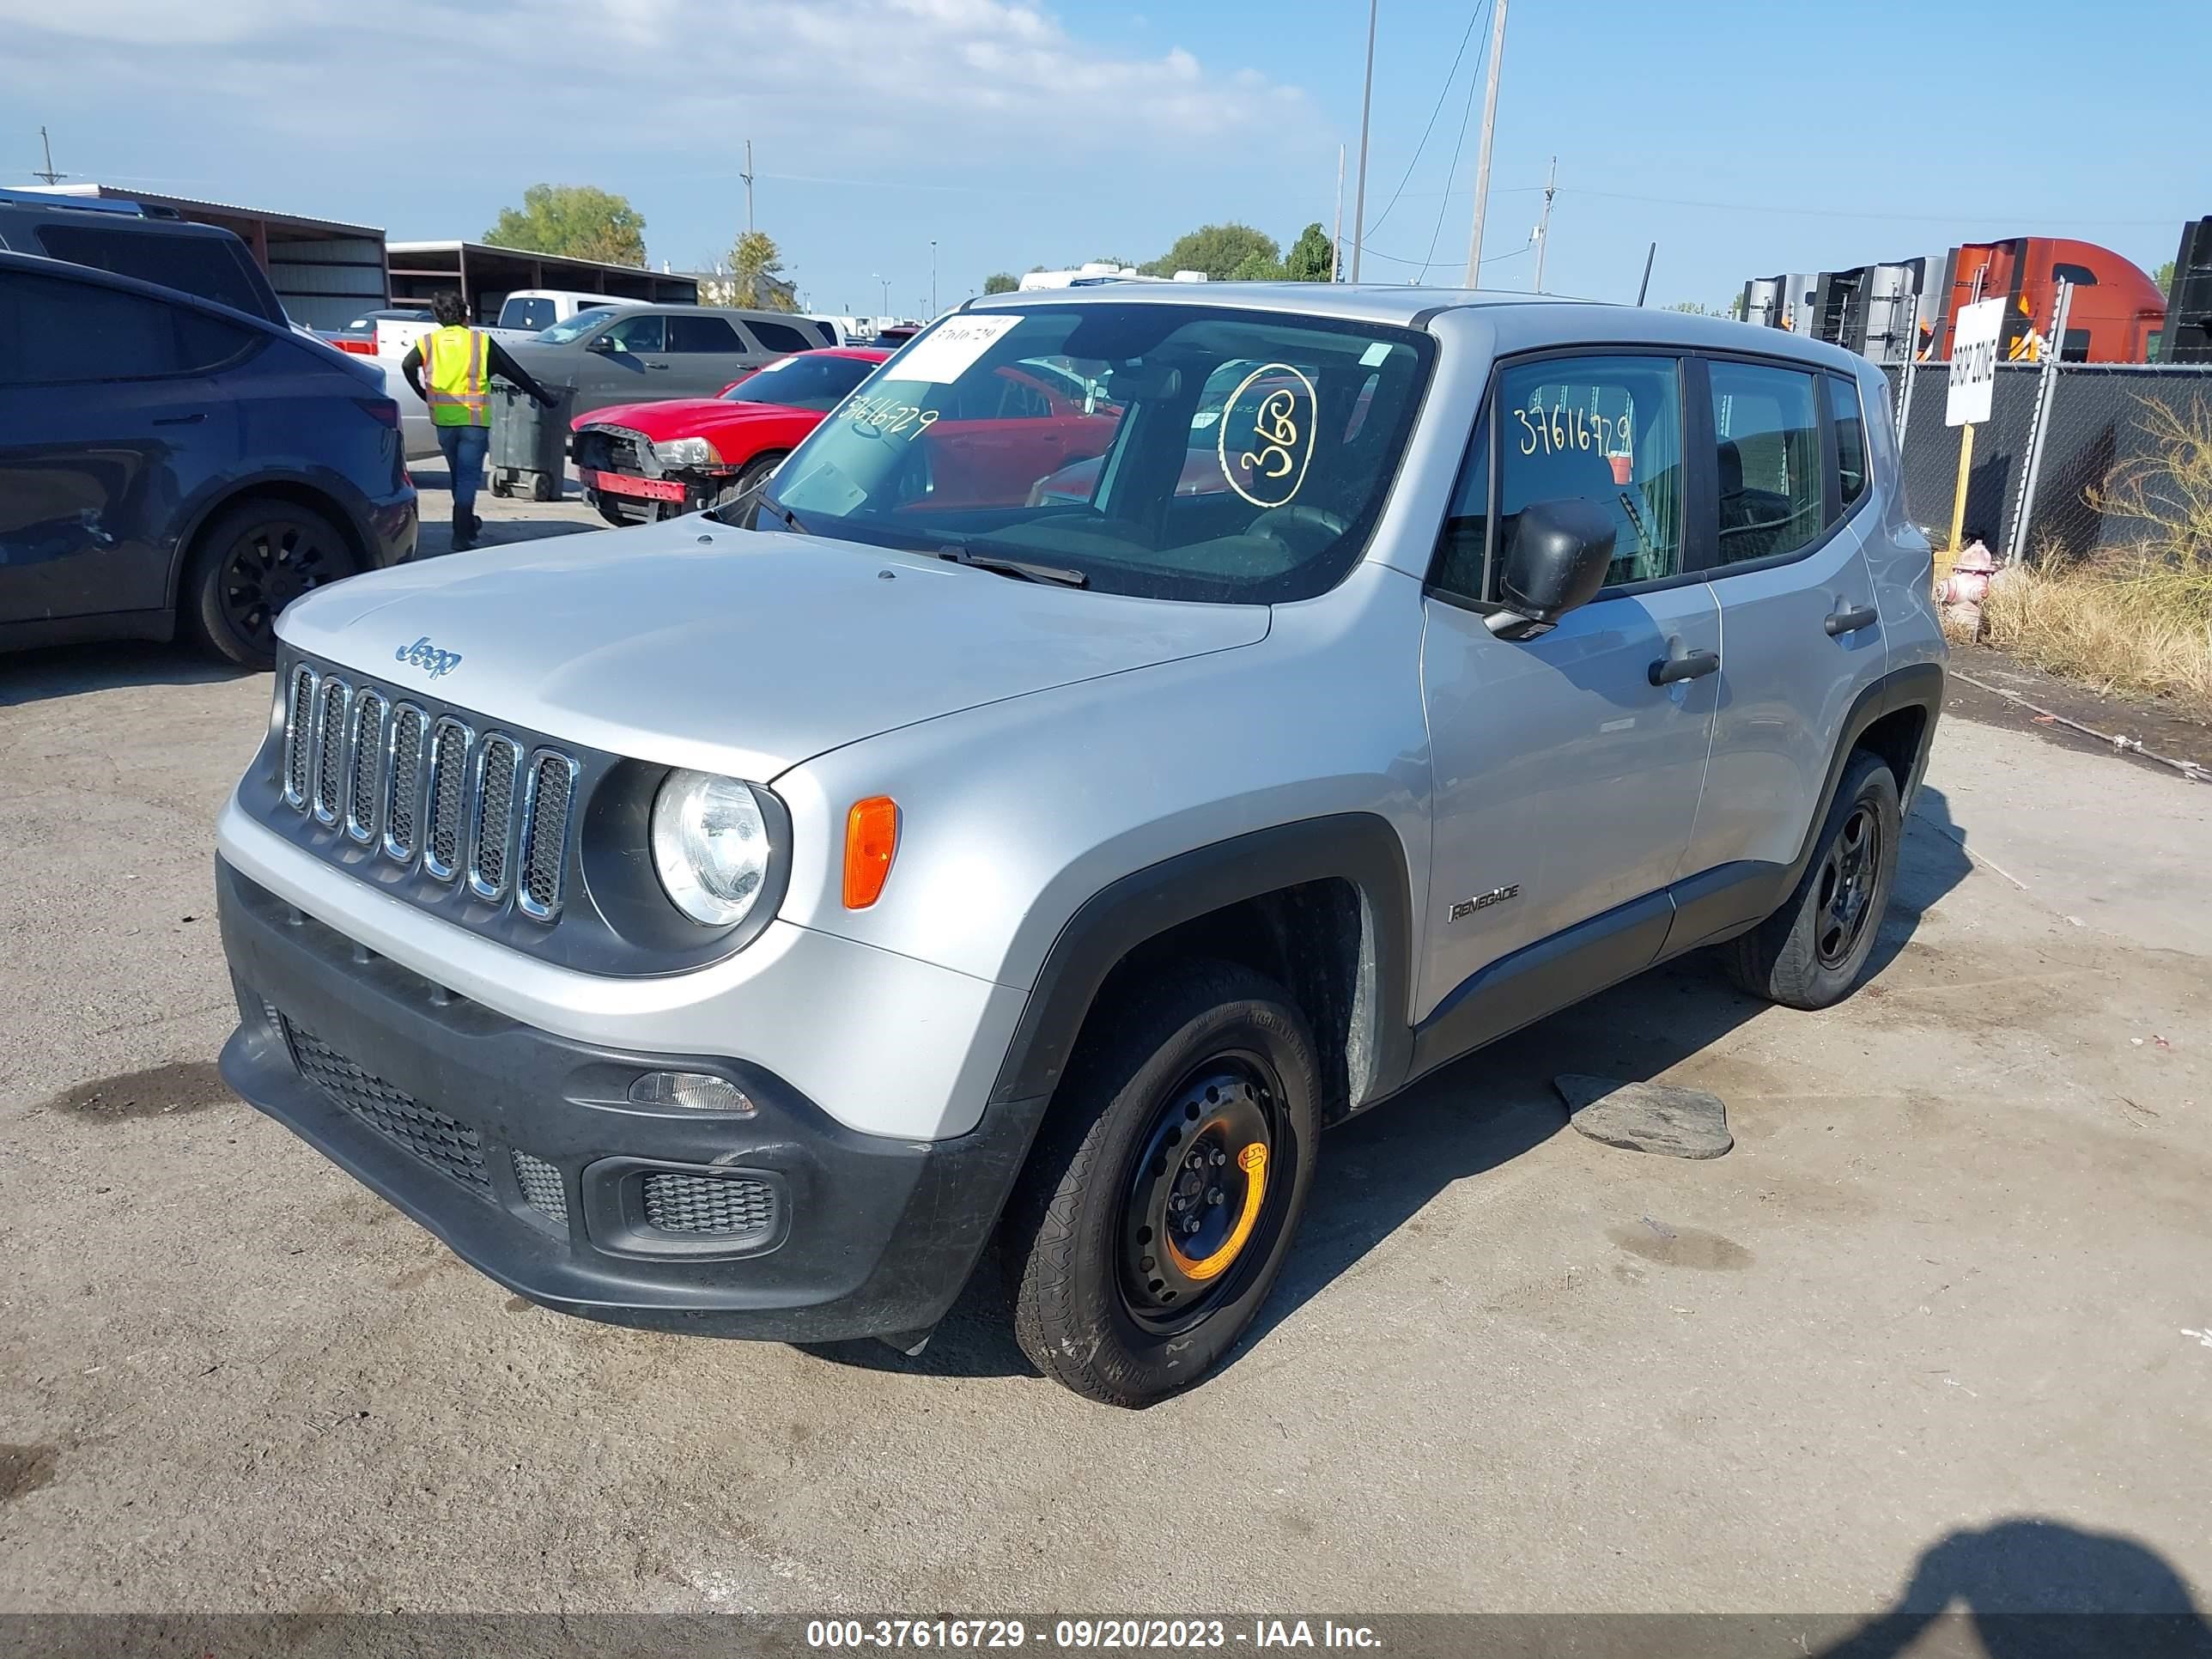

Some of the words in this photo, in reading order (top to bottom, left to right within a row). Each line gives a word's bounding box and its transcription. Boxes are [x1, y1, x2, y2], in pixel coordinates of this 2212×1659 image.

[1950, 343, 1972, 387] DROP
[1972, 338, 1996, 383] ZONE
[1241, 389, 1297, 477] 360
[1513, 404, 1634, 468] 37616729
[395, 635, 463, 681] Jeep
[1447, 883, 1520, 924] RENEGADE
